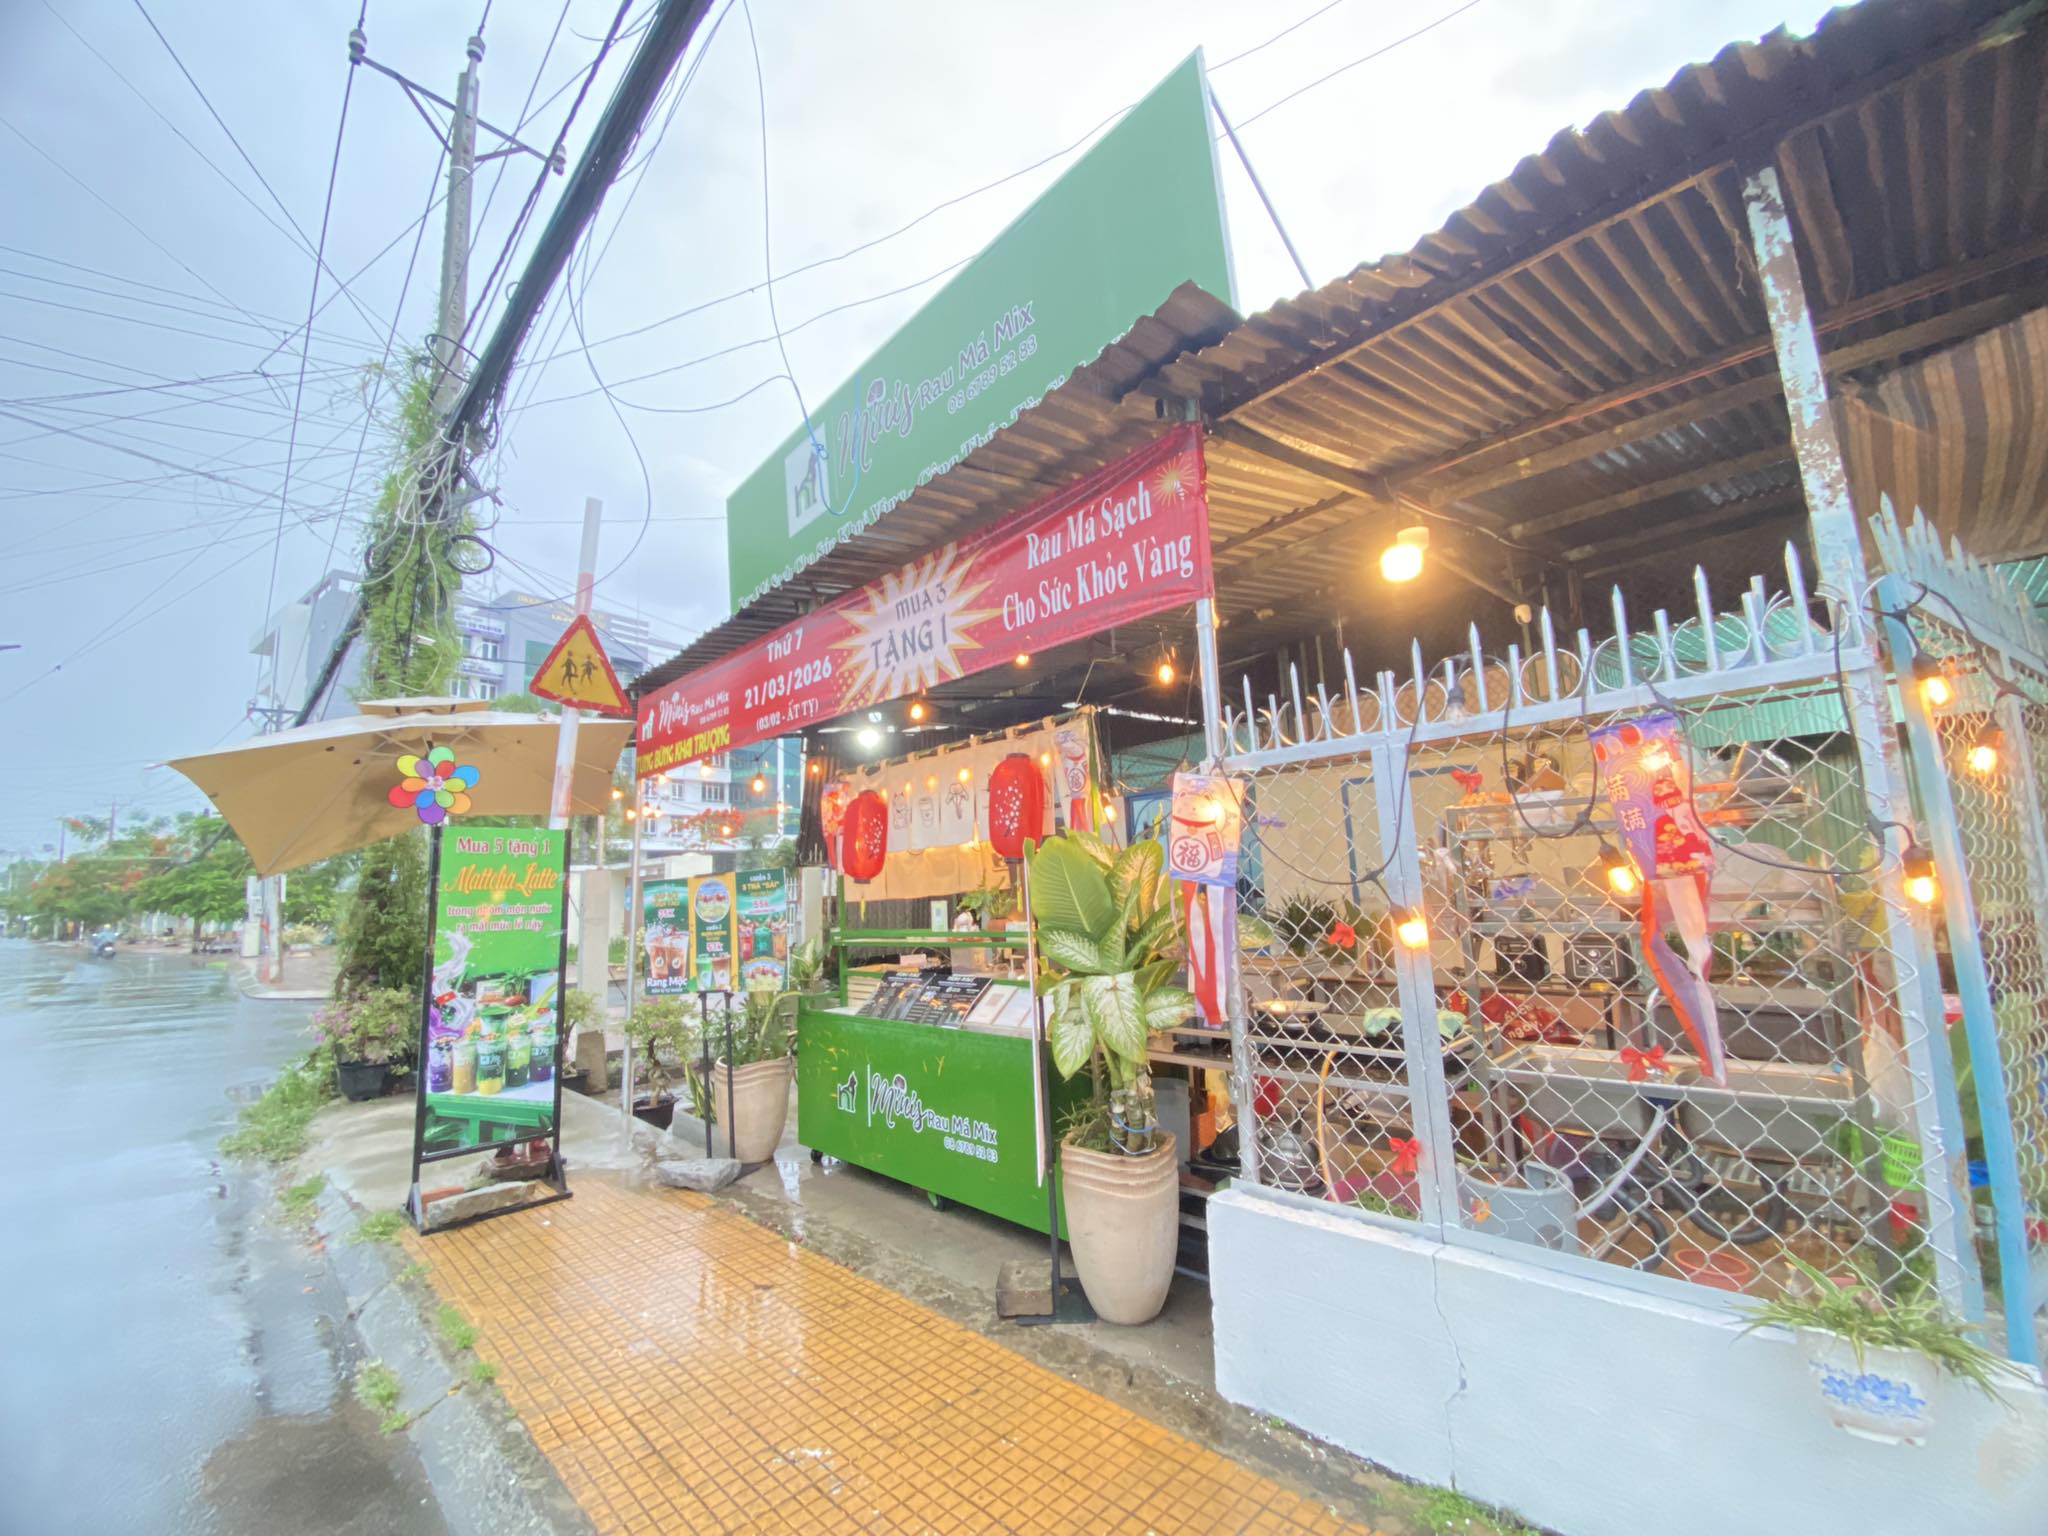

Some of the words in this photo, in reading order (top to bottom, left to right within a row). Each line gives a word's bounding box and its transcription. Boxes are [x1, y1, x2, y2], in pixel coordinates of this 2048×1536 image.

[918, 366, 954, 411] Rau
[958, 330, 989, 380] Má
[993, 300, 1036, 352] Mix
[947, 389, 965, 415] 08
[966, 363, 998, 401] 6789
[1026, 532, 1062, 570] Rau
[1066, 505, 1095, 552] Má
[1101, 481, 1152, 538] Sạch
[895, 589, 933, 621] MUA
[936, 581, 947, 604] 3
[1003, 592, 1036, 631] Cho
[1039, 576, 1072, 618] Sức
[1076, 552, 1128, 605] Khỏe
[1133, 536, 1194, 583] Vàng
[767, 632, 793, 663] Thứ
[795, 626, 804, 651] 7
[871, 619, 934, 673] TẶNG
[744, 655, 832, 710] 21/03/2026
[457, 836, 490, 854] Mua
[494, 837, 503, 854] 5
[508, 838, 538, 858] tặng
[543, 838, 551, 854] 1
[1176, 841, 1201, 869] 福
[513, 862, 558, 897] Latte
[925, 1110, 950, 1132] Rau
[951, 1115, 971, 1138] Má
[973, 1120, 998, 1145] Mix
